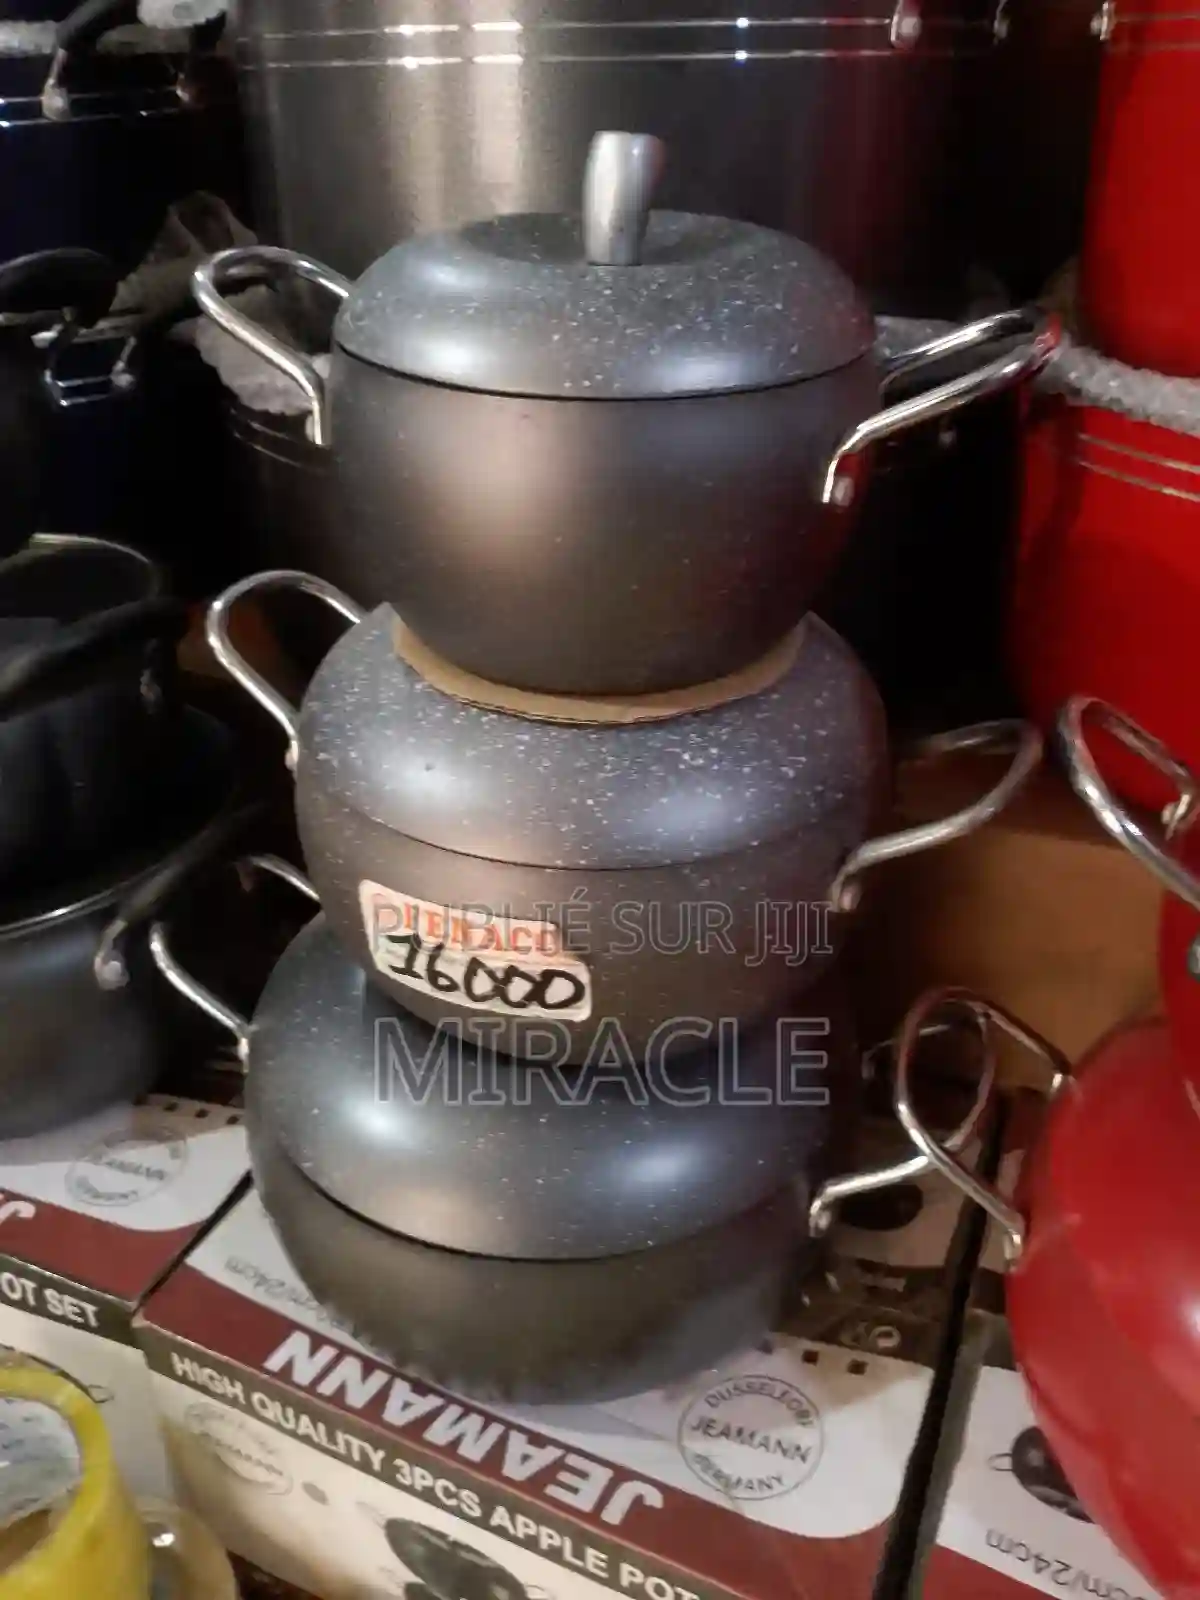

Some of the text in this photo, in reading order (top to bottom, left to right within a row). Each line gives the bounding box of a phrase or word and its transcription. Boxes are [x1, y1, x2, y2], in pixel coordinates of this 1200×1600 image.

[386, 932, 585, 1009] 16000
[44, 1288, 100, 1328] SET
[172, 1352, 245, 1405] HIGH
[252, 1396, 386, 1469] QUALITY
[395, 1458, 482, 1517] 3PCS
[490, 1504, 609, 1578] APPLE
[264, 1330, 664, 1526] JEAMANN
[691, 1415, 812, 1464] JEAMANN
